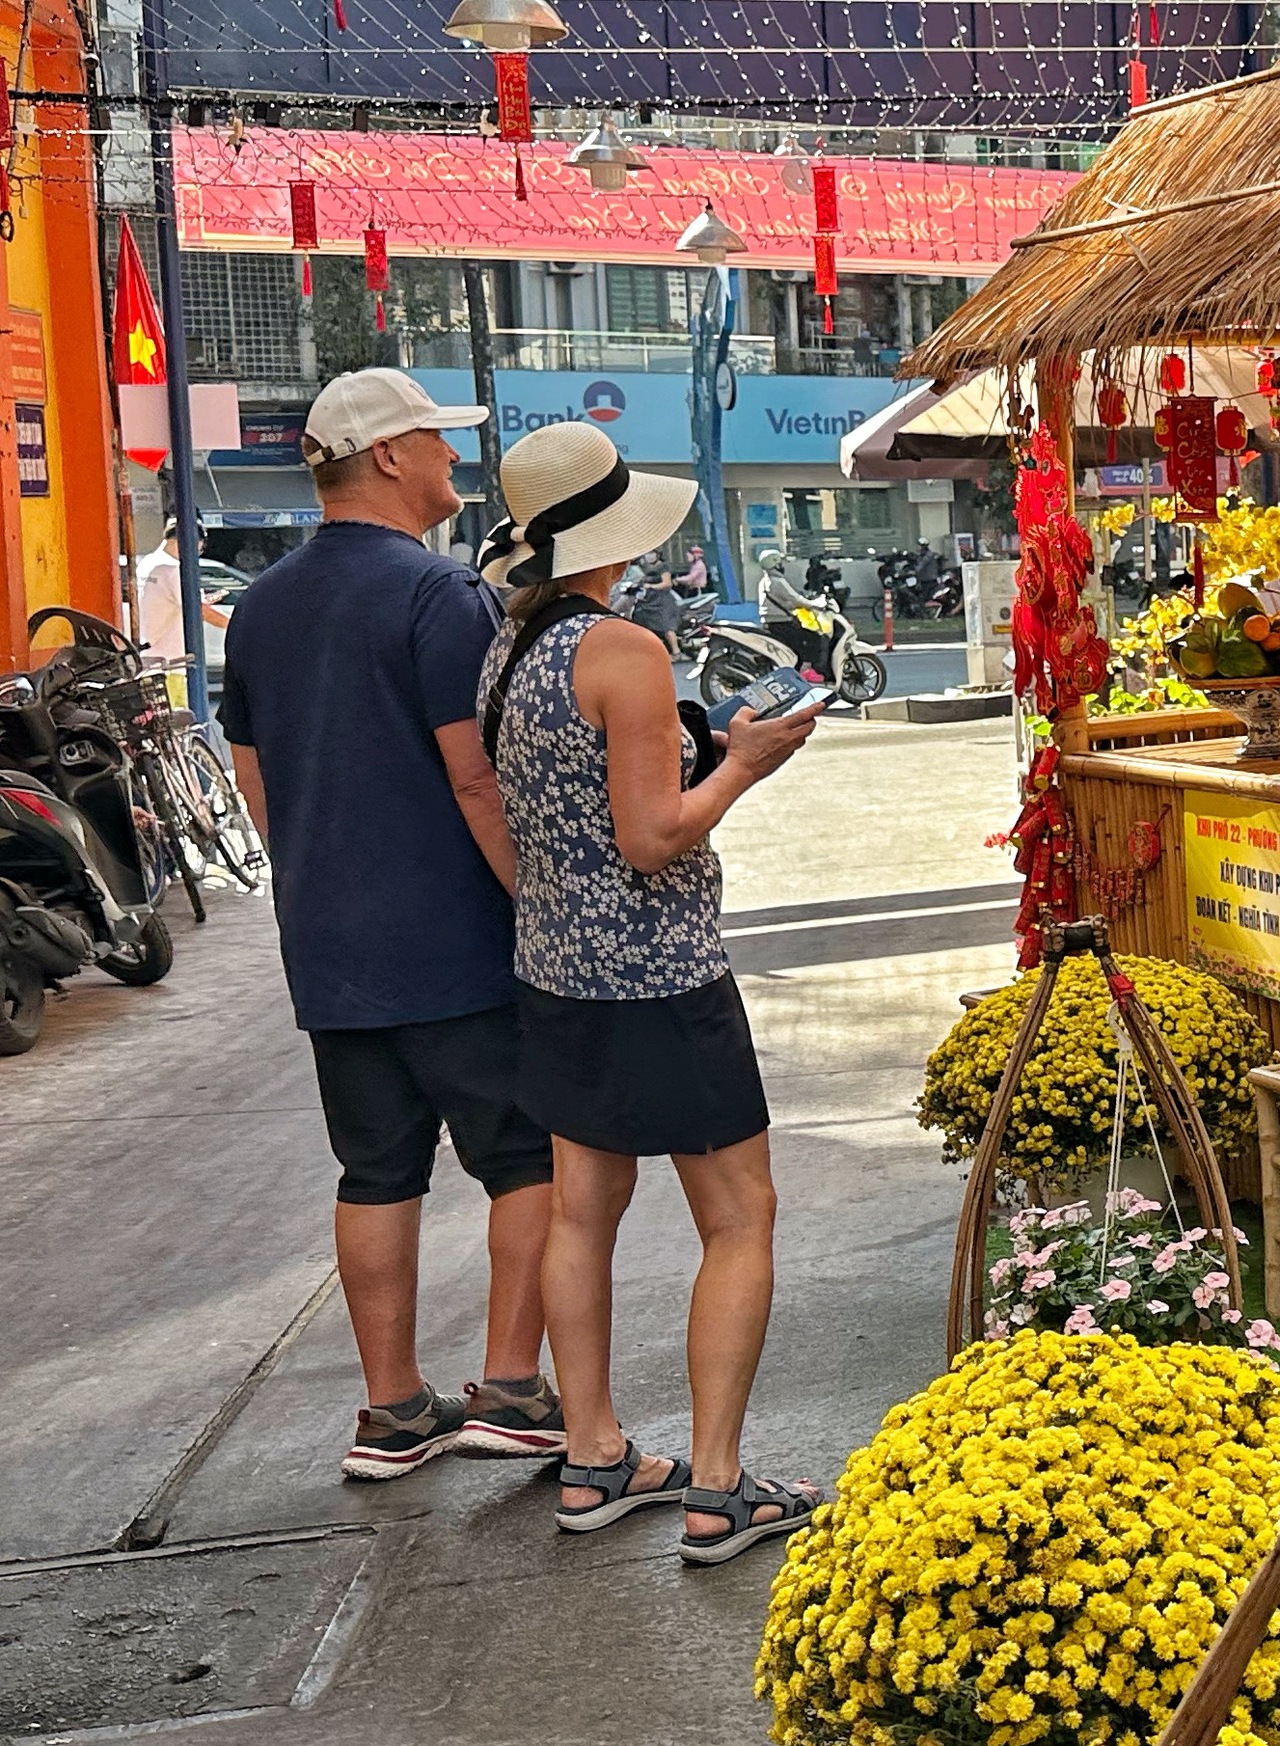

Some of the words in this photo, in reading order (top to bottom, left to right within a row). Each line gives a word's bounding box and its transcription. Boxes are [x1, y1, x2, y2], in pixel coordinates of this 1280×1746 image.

[1197, 817, 1211, 838] KHU
[1213, 818, 1229, 840] PHỐ
[1230, 824, 1241, 843] 22
[1248, 825, 1277, 852] PHƯỜNG
[1220, 856, 1234, 884] XÂY
[1236, 865, 1257, 892] DỰNG
[1259, 870, 1273, 894] KHU
[1195, 893, 1216, 920] ĐOÀN
[1218, 898, 1231, 924] KẾT
[1239, 904, 1261, 932] NGHĨA
[1262, 908, 1280, 937] TÌNH
